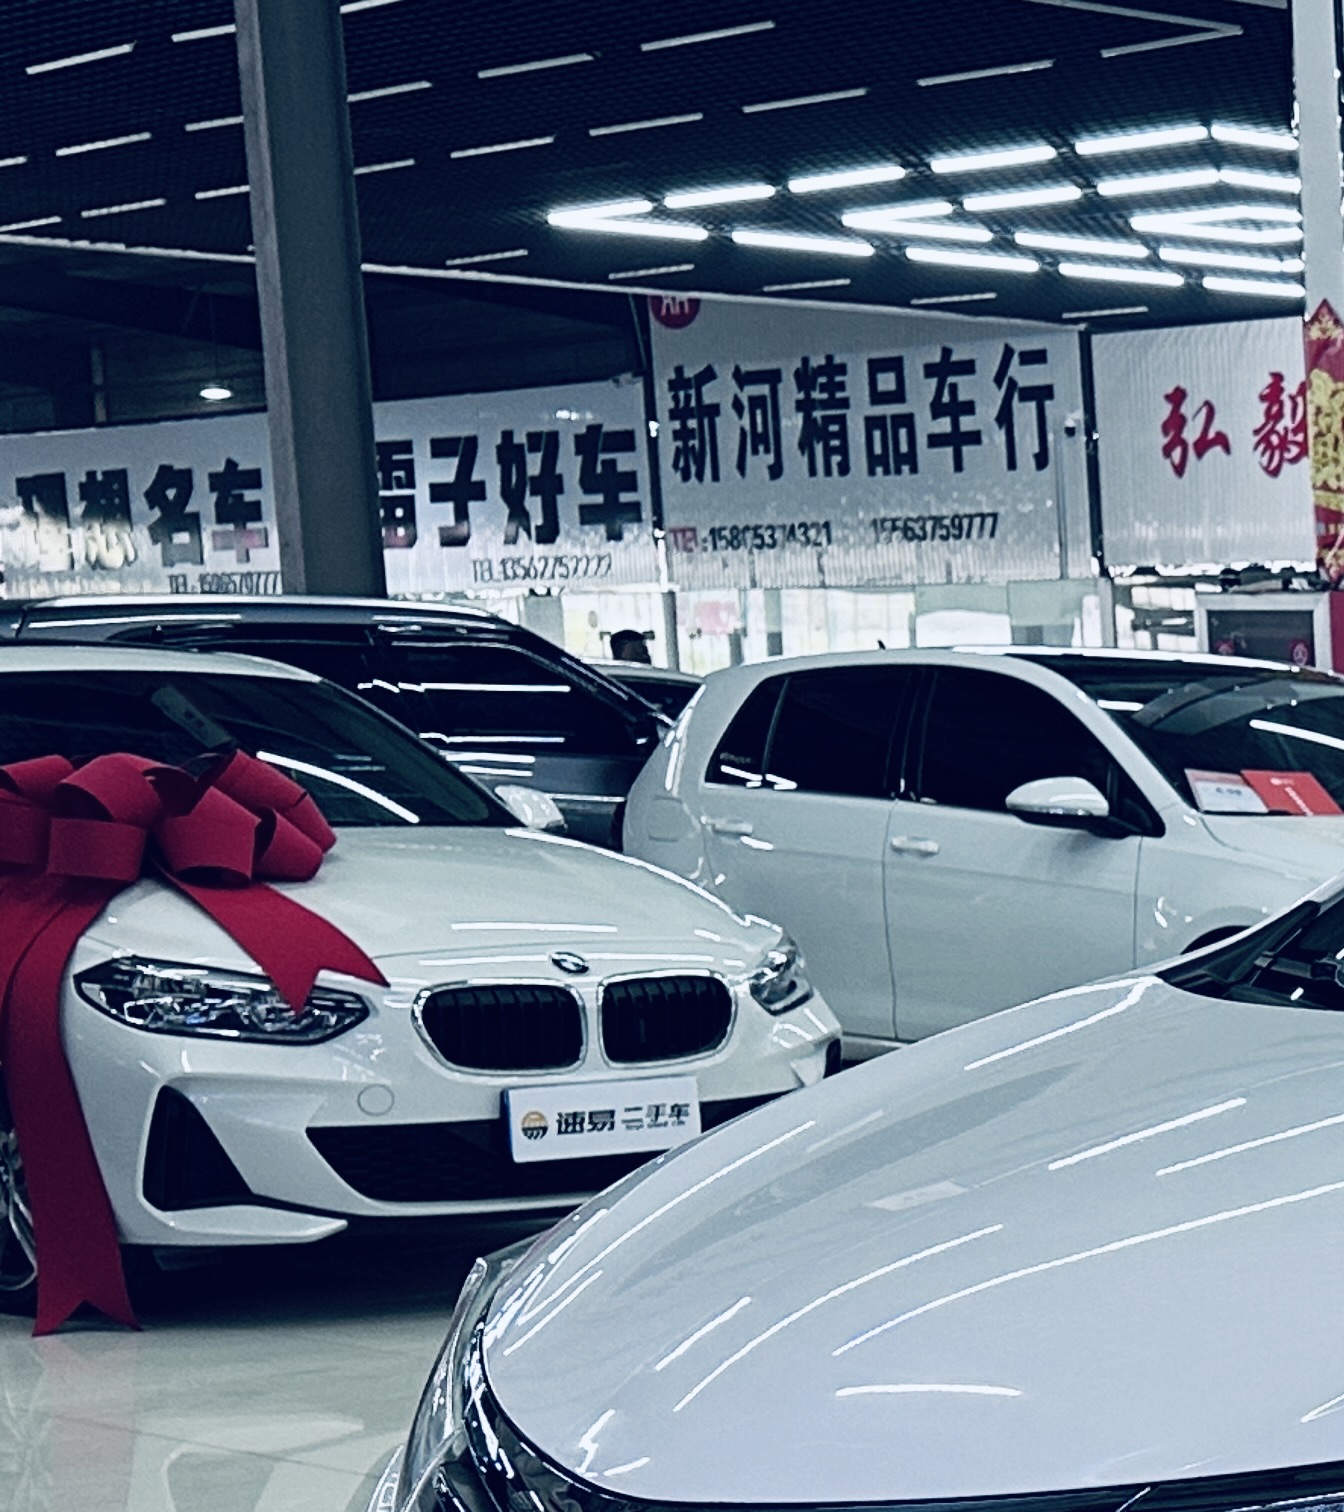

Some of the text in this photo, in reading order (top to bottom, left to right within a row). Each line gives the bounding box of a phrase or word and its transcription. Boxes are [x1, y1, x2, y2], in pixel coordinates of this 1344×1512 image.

[668, 342, 1055, 482] 新河精品车行
[556, 1110, 616, 1136] 速易
